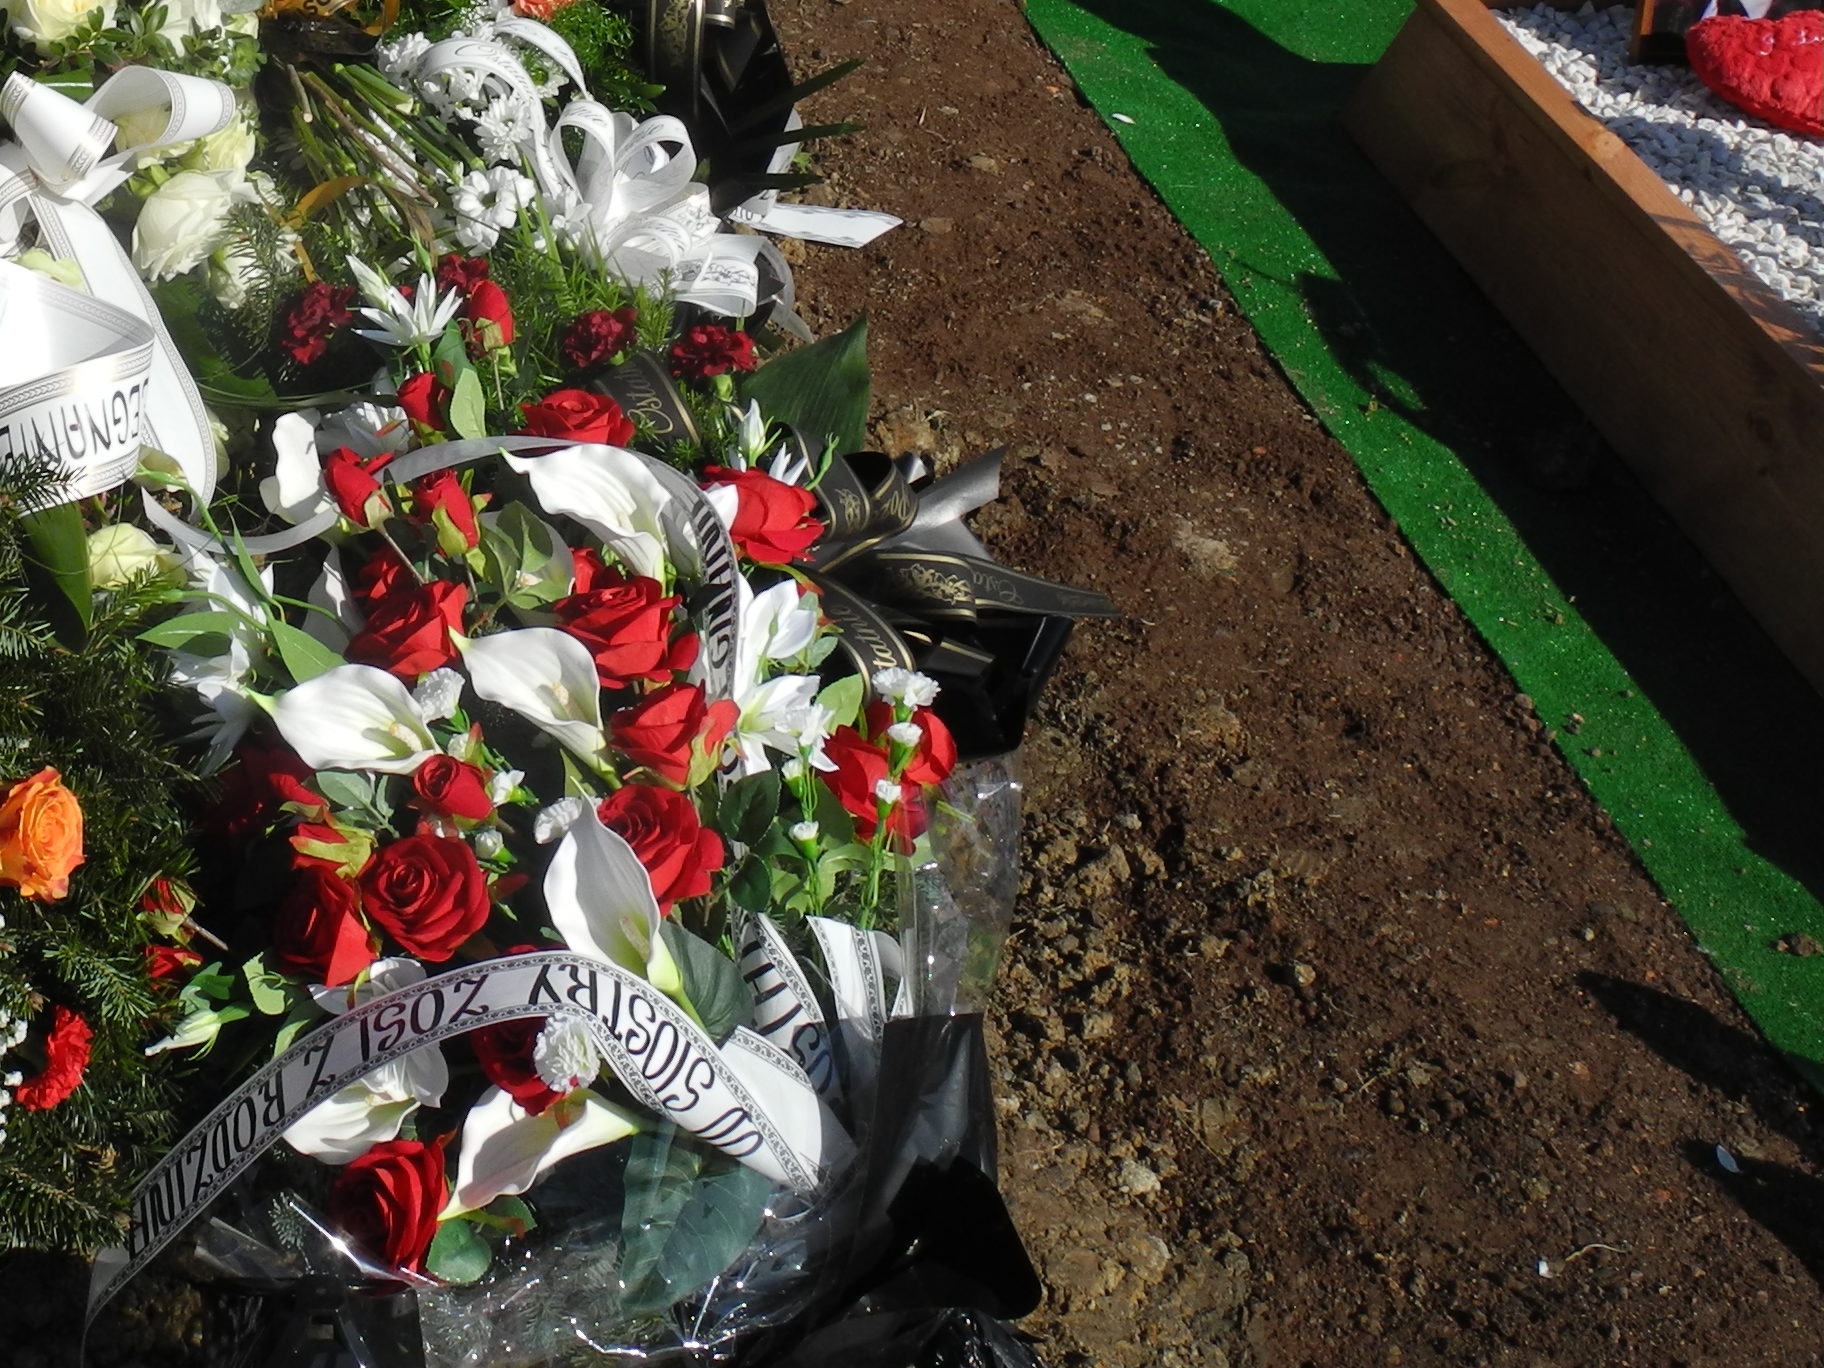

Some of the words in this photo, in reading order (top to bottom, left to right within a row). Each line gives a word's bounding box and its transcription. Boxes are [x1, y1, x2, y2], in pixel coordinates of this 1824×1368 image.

[358, 974, 490, 1062] ZOSI
[527, 963, 719, 1111] SIOSTRY
[303, 1046, 340, 1091] Z
[697, 1106, 766, 1159] OD
